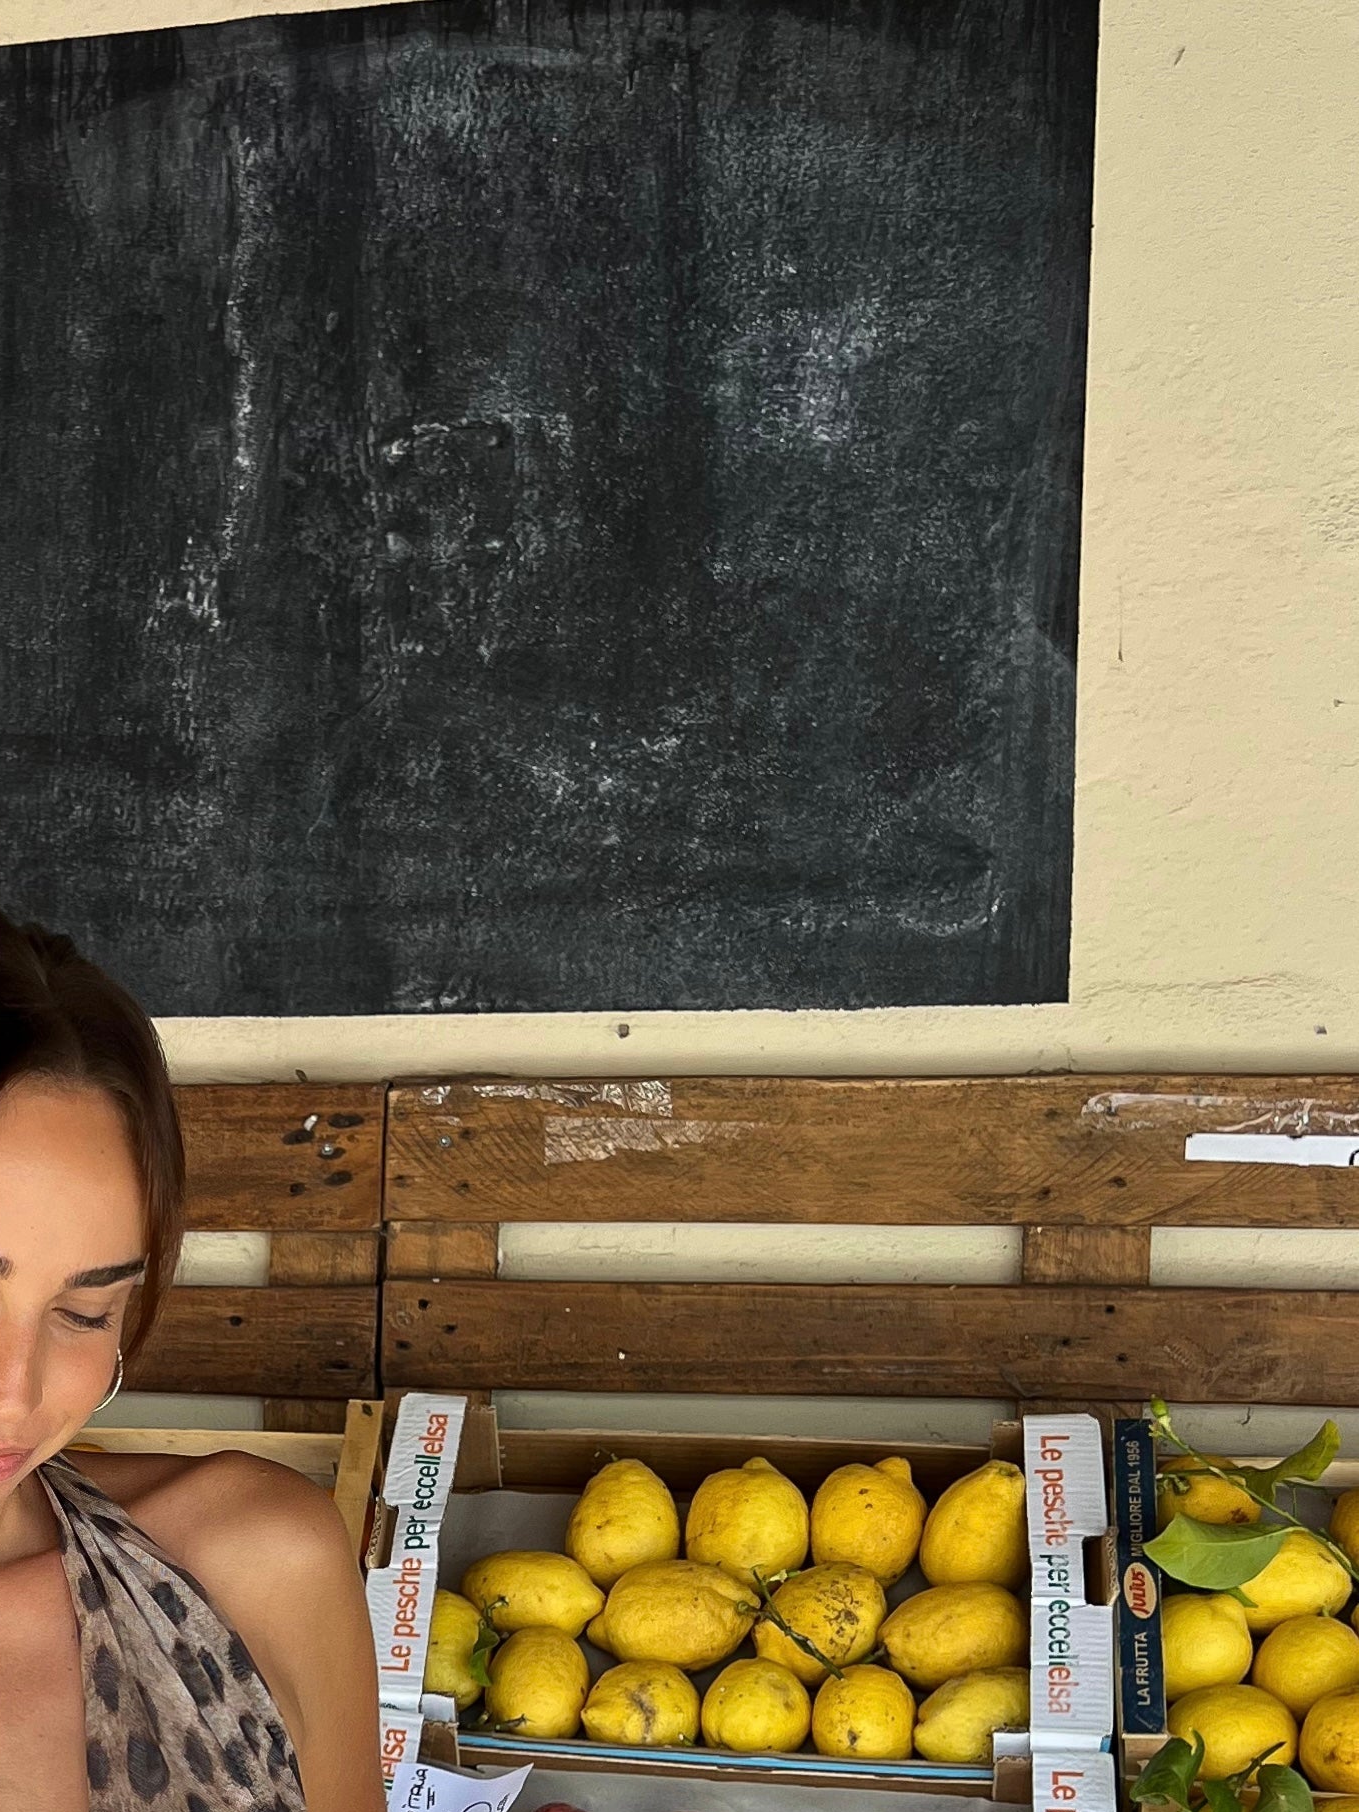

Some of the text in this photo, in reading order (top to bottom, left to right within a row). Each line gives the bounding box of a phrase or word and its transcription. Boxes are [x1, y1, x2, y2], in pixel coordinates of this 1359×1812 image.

[1040, 1434, 1070, 1462] Le
[1128, 1466, 1144, 1494] DAL
[1035, 1465, 1074, 1546] pesche
[1128, 1495, 1144, 1557] MIGLIORE
[381, 1412, 449, 1673] Le pesche per eccellelsa
[1039, 1554, 1070, 1593] per
[1134, 1632, 1151, 1706] LA FRUTTA
[1050, 1770, 1084, 1801] Le
